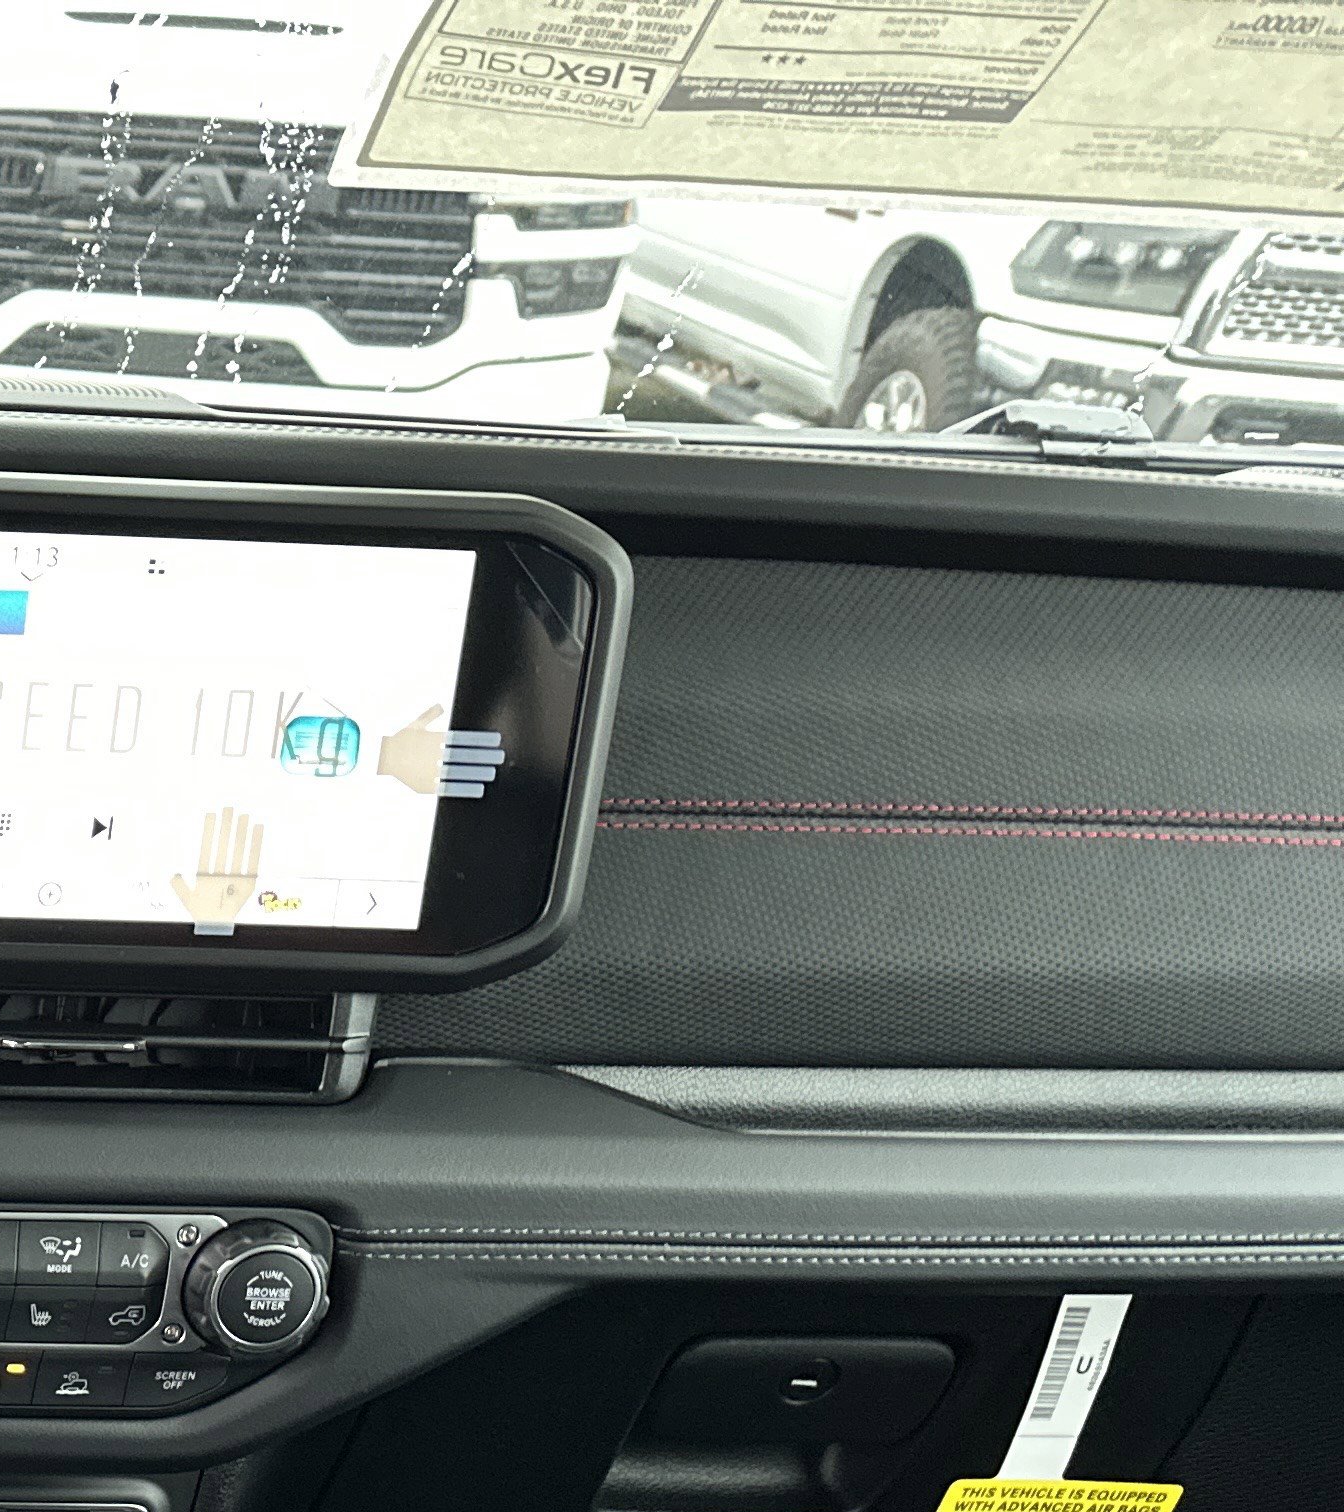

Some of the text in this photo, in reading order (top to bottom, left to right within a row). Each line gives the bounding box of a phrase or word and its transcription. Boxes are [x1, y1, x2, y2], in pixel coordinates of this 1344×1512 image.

[120, 1253, 149, 1269] A/C
[46, 1263, 72, 1274] MODE
[259, 1270, 285, 1281] TUNE
[246, 1287, 292, 1299] BROWSE
[250, 1301, 286, 1311] ENTER
[247, 1315, 282, 1327] SCROLL
[155, 1370, 197, 1382] SCREEN
[163, 1380, 184, 1391] OFF
[961, 1487, 1168, 1503] THIS VEHICLE IS EQUIPPED
[954, 1500, 993, 1512] WITH
